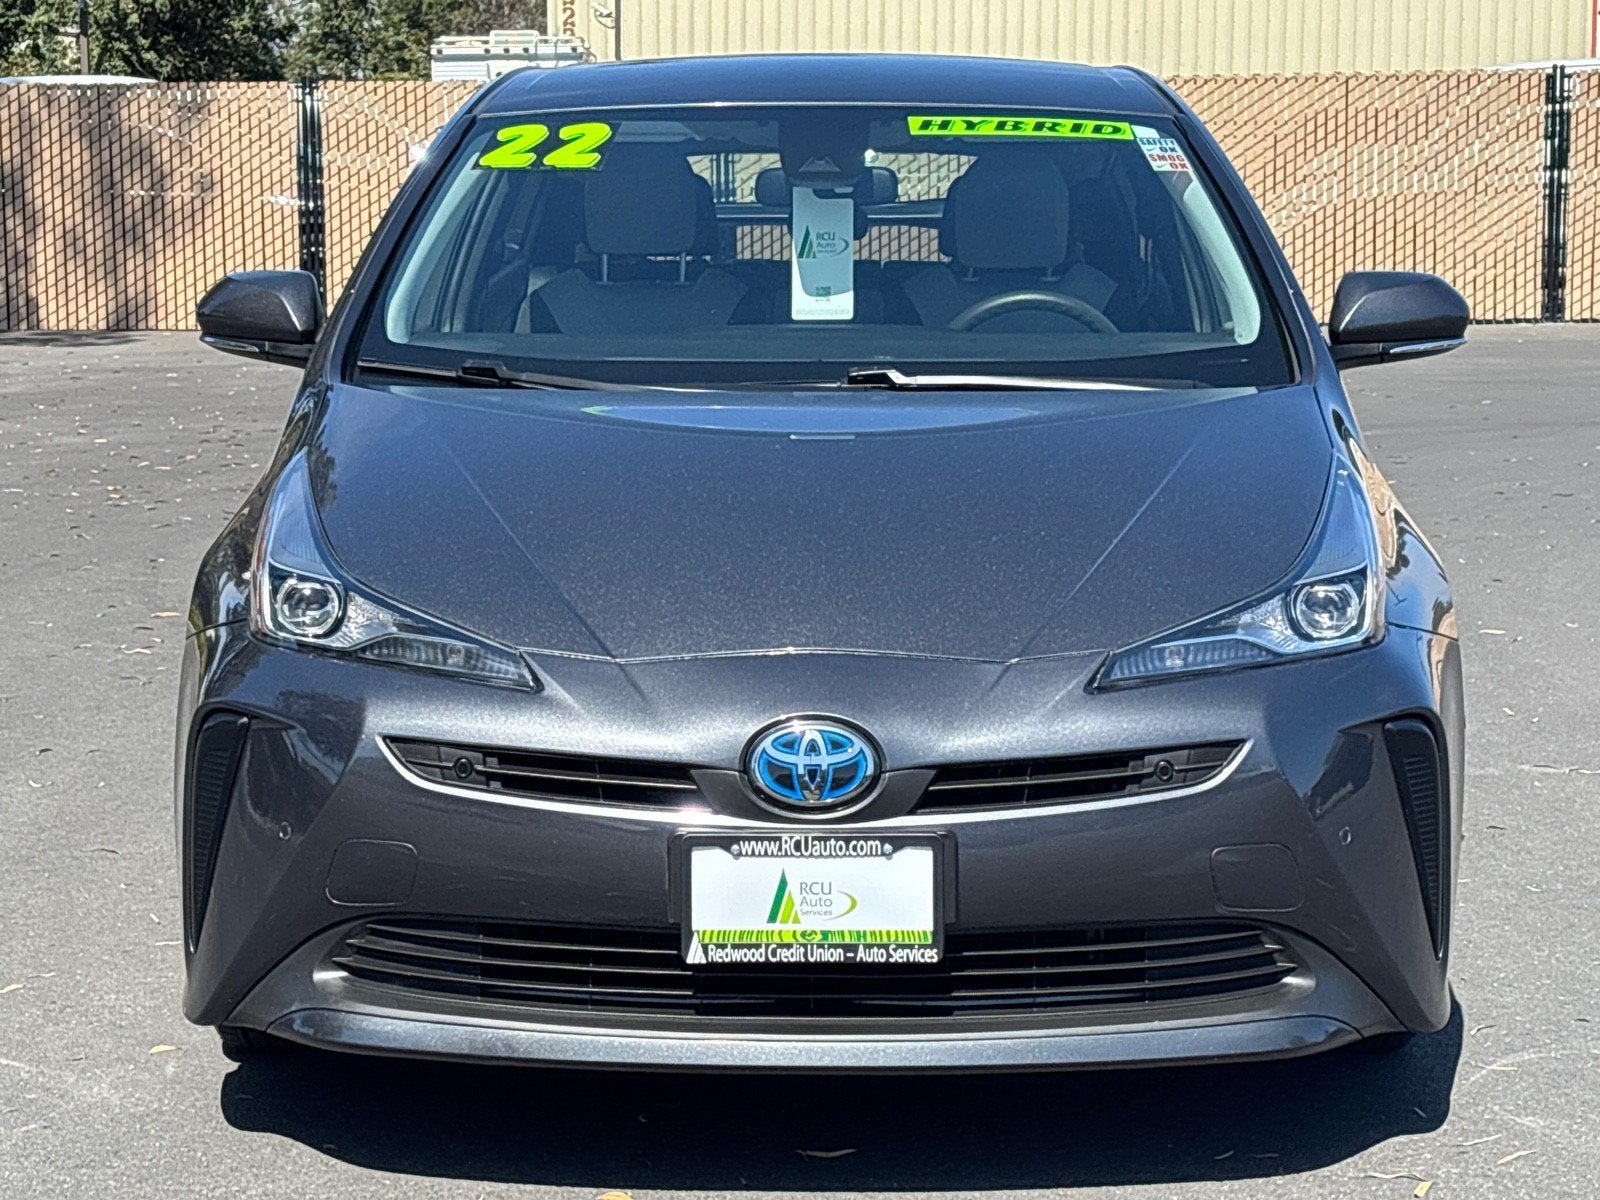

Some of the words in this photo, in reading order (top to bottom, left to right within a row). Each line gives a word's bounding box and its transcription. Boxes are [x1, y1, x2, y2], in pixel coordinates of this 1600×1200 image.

[917, 119, 1127, 136] HYBRID
[479, 122, 612, 168] 22
[1149, 154, 1185, 162] SMOG
[816, 232, 836, 241] RCU
[739, 836, 882, 857] www.RCUauto.com
[800, 882, 832, 895] RCU
[800, 897, 833, 908] Auto
[800, 909, 833, 917] Services
[708, 944, 766, 963] Redwood
[768, 944, 805, 963] Credit
[808, 945, 843, 963] Union
[857, 945, 886, 963] Auto
[889, 945, 938, 964] Services
